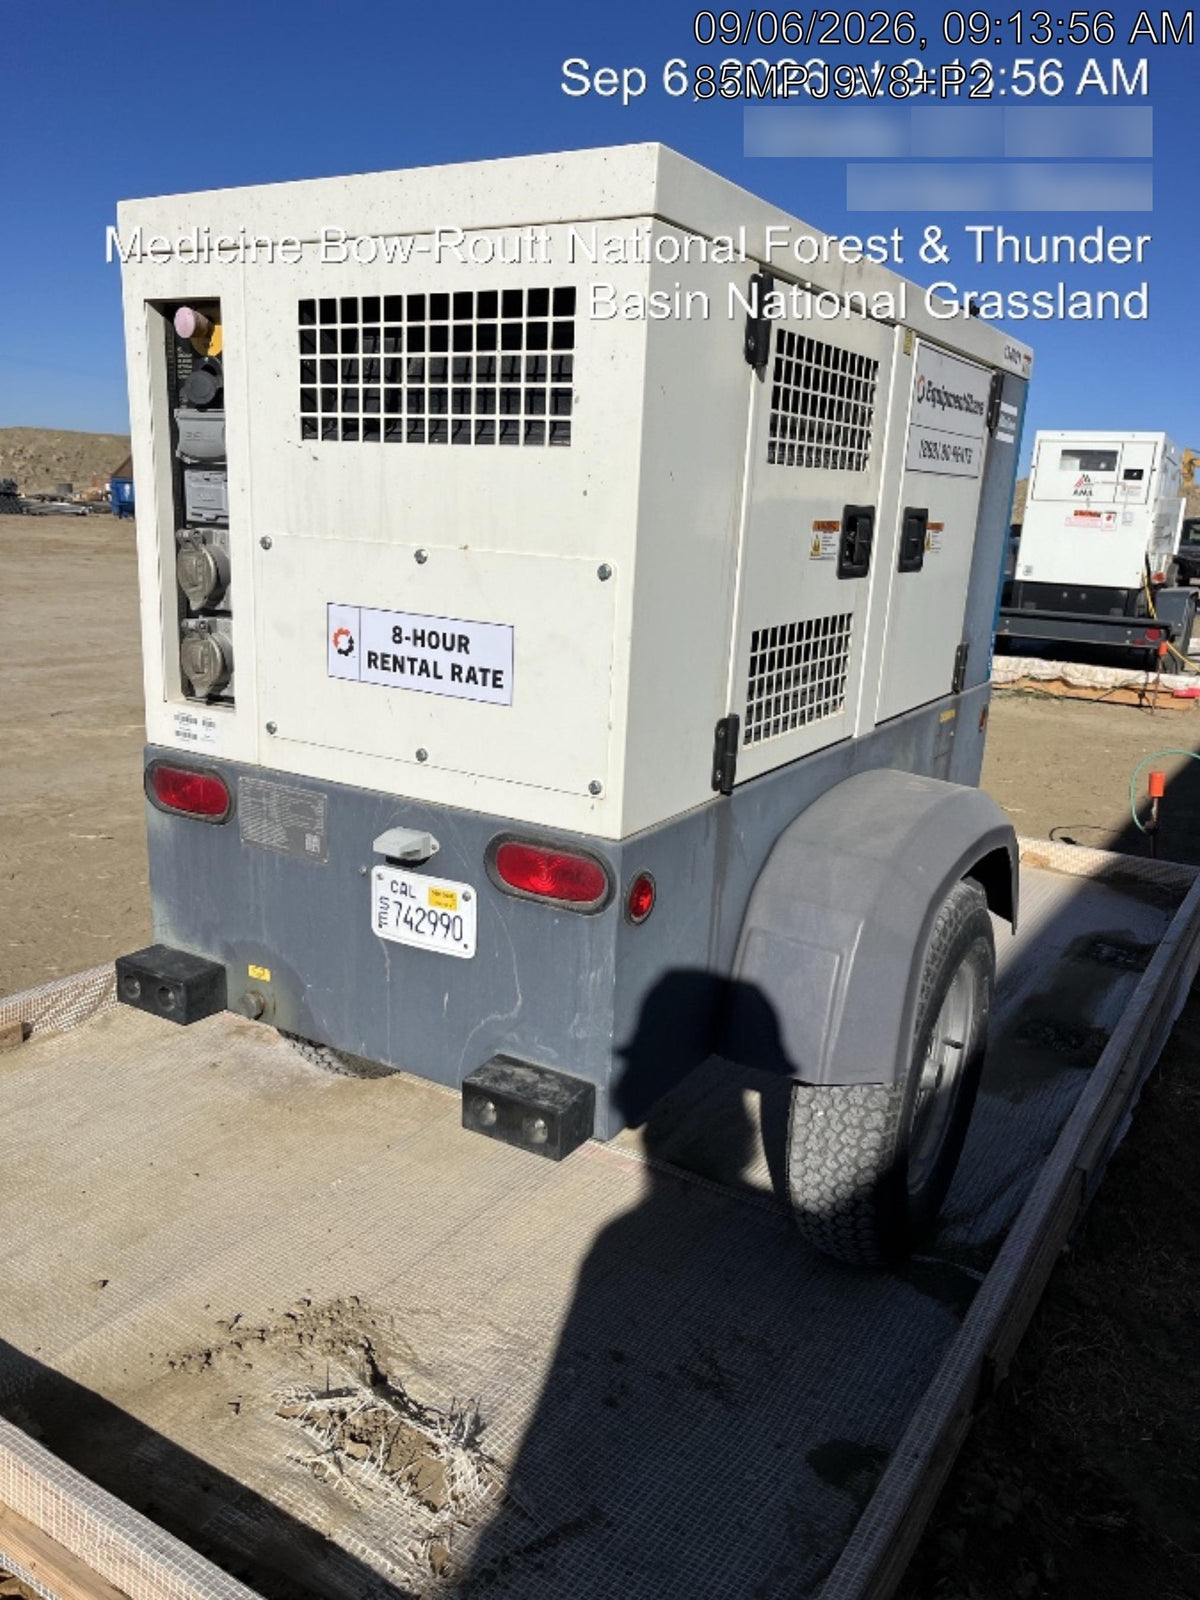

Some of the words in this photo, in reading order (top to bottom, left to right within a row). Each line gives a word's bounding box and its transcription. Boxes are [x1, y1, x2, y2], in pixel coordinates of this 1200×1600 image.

[392, 625, 471, 655] 8-HOUR
[367, 650, 443, 680] RENTAL
[451, 662, 505, 690] RATE
[390, 880, 417, 899] CAL
[393, 900, 464, 942] 742990
